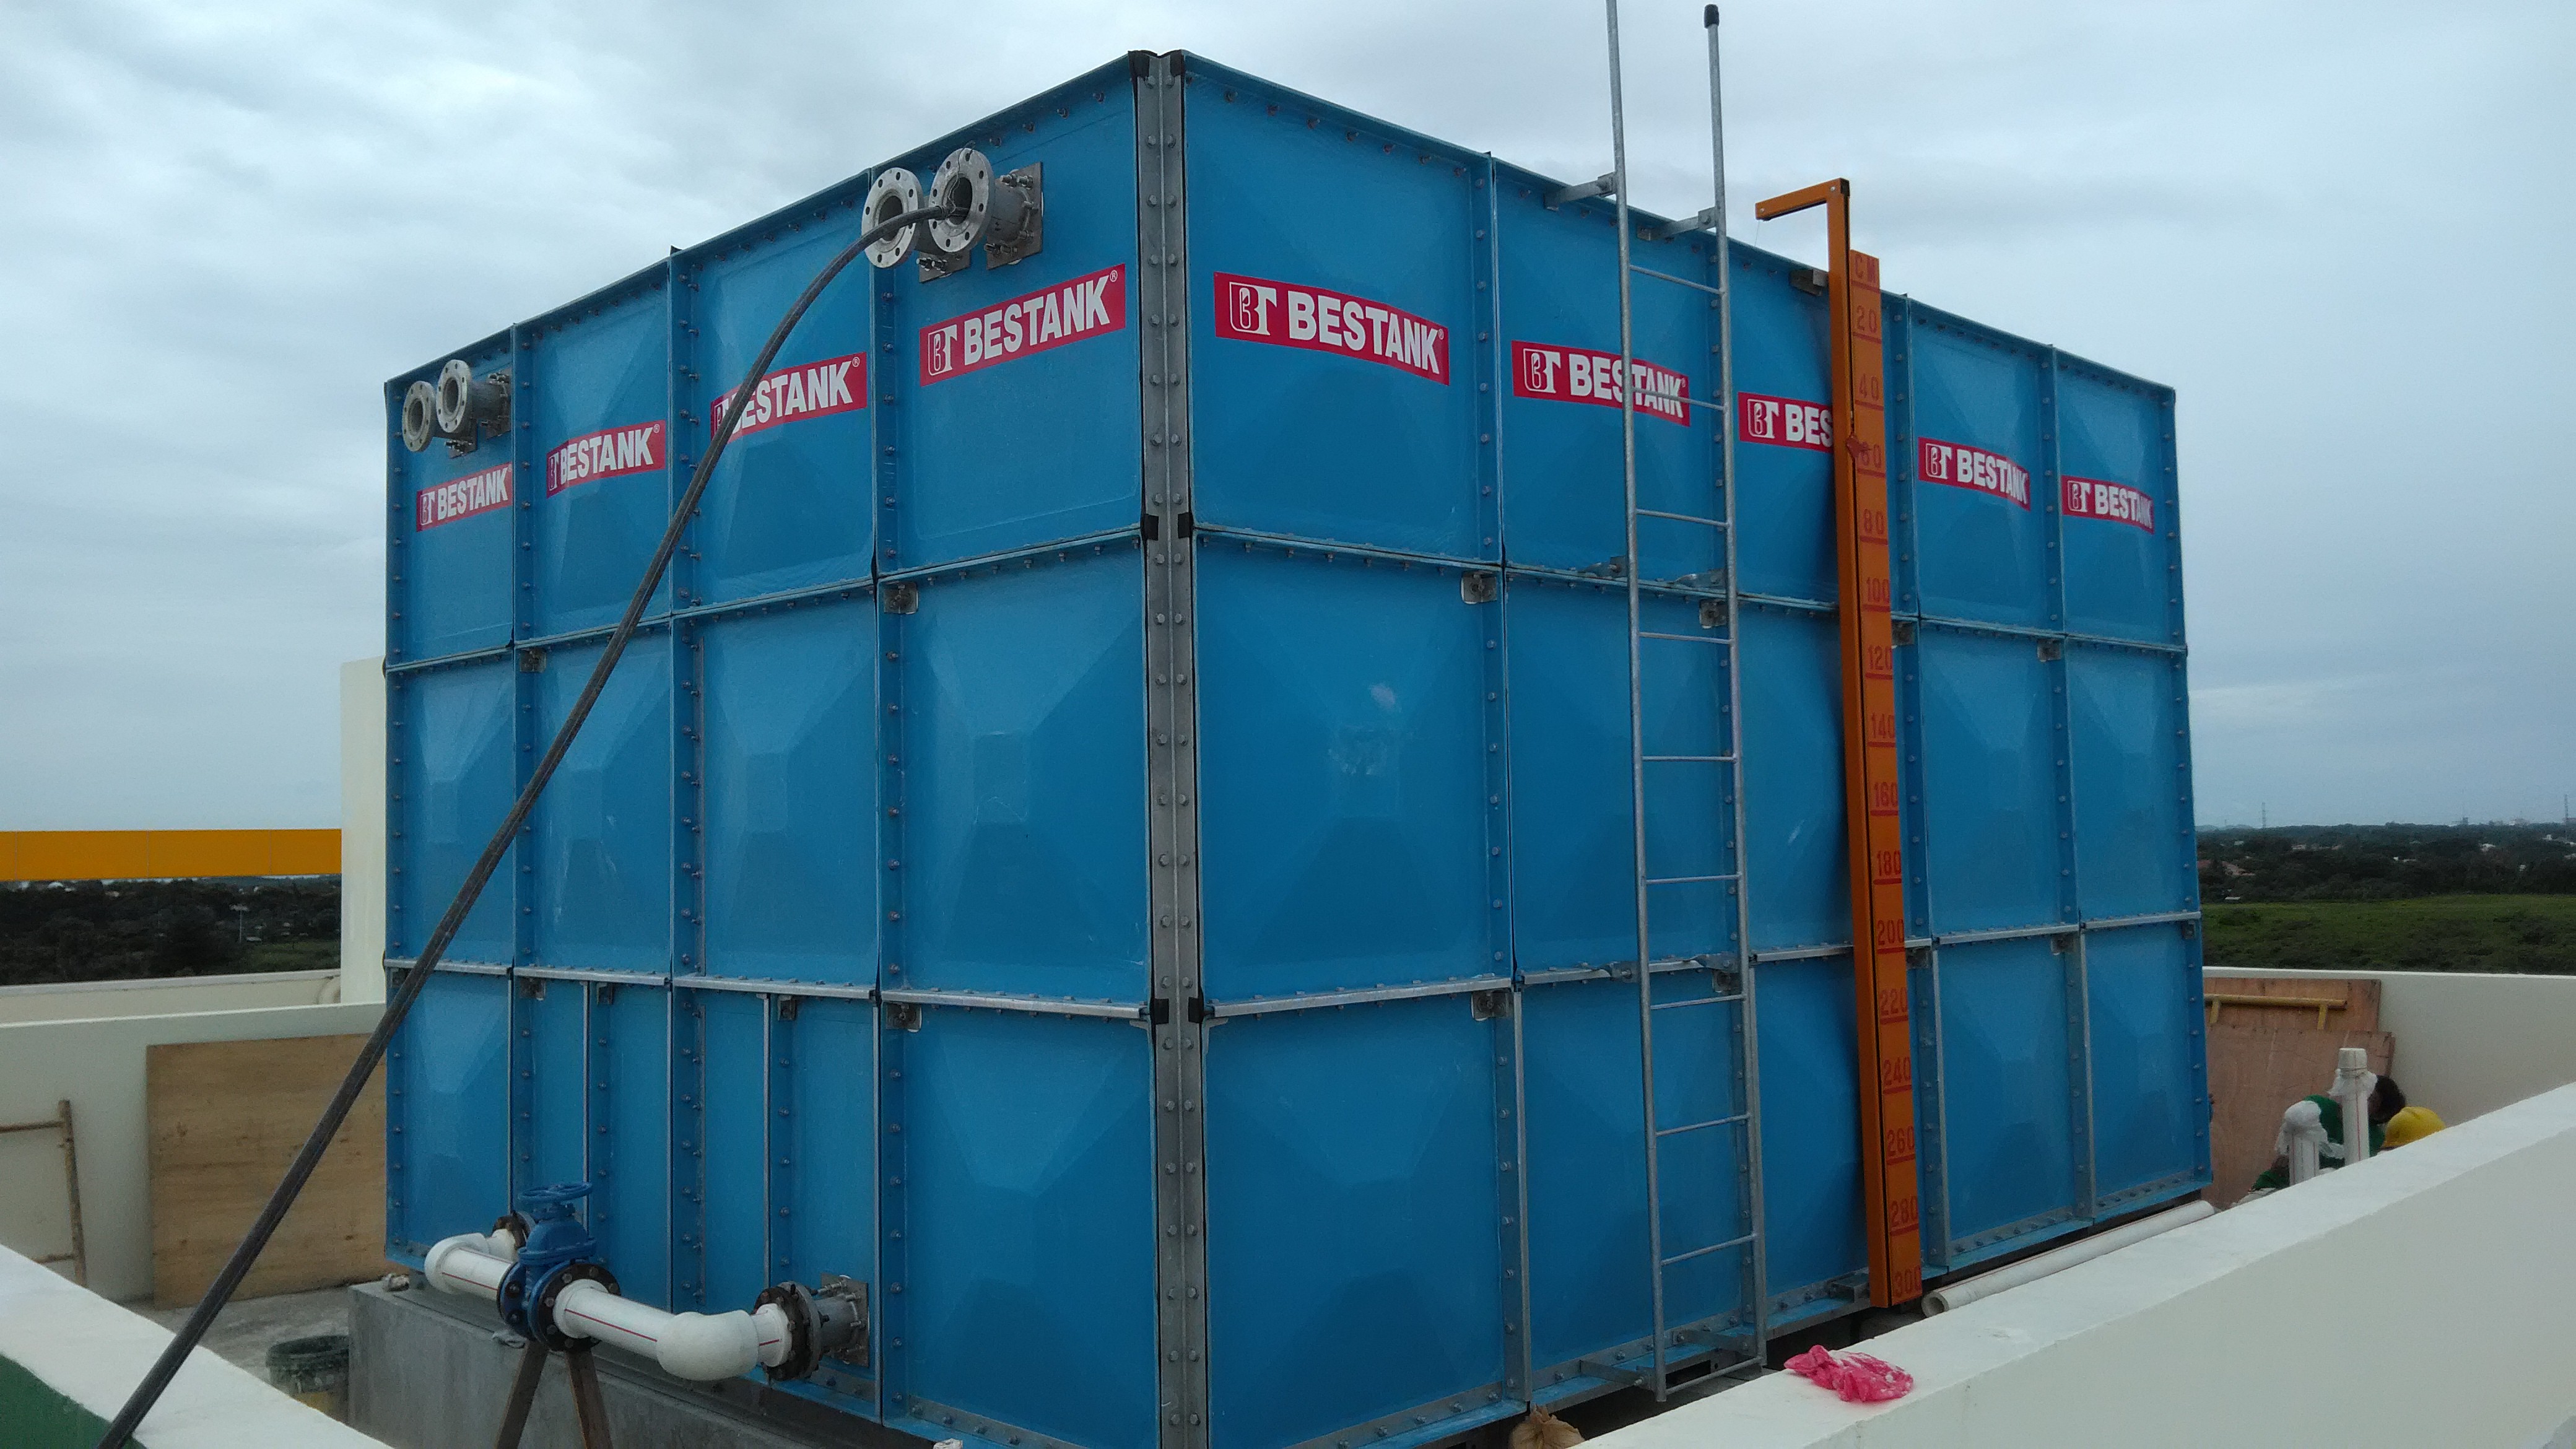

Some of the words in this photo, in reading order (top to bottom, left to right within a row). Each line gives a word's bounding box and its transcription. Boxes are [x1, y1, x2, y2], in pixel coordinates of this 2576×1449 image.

[964, 275, 1110, 366] BESTANK
[1287, 290, 1440, 375] BESTANK
[1858, 305, 1877, 333] 20
[1859, 373, 1879, 401] 40
[560, 427, 653, 485] BESTANK
[1957, 449, 2028, 505] BESTANK
[437, 467, 508, 520] BESTANK
[1863, 508, 1885, 535] 80
[1866, 577, 1890, 604] 100
[1867, 645, 1892, 671] 120
[1871, 713, 1895, 739] 140
[1873, 781, 1897, 807] 160
[1876, 850, 1901, 877] 180
[1877, 918, 1904, 946] 200
[1879, 987, 1908, 1016] 220
[1883, 1056, 1911, 1086] 240
[1887, 1125, 1915, 1157] 260
[1890, 1195, 1918, 1228] 280
[1894, 1266, 1921, 1298] 300
